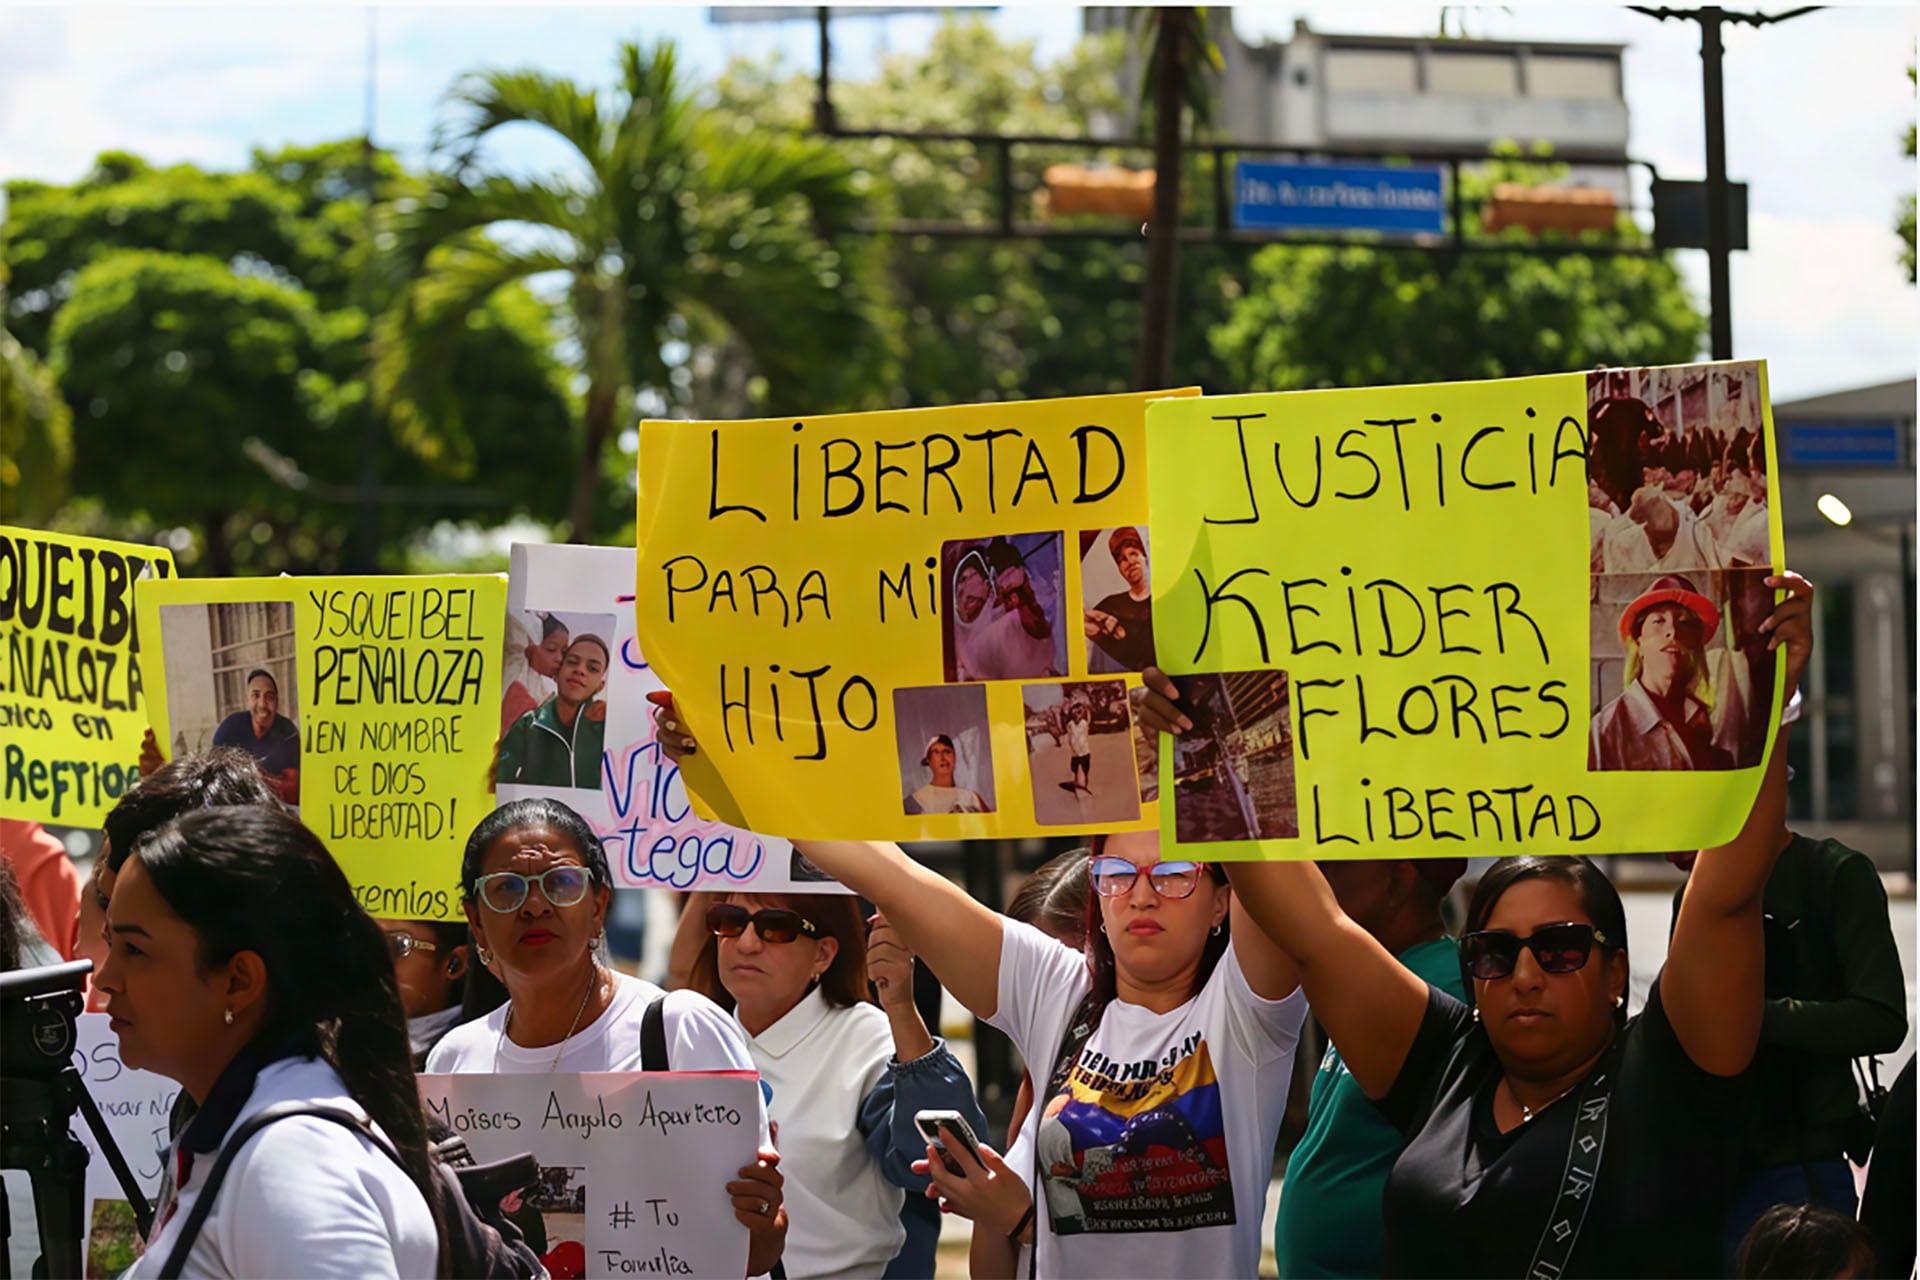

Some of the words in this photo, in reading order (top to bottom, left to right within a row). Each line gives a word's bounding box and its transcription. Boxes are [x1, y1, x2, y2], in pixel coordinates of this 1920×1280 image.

[309, 588, 484, 641] YSQUEIBEL
[661, 555, 831, 628] PARA
[313, 644, 484, 706] PEÑALOZA
[359, 714, 463, 754] NOMBRE
[1295, 674, 1570, 760] FLORES
[334, 764, 361, 796] DE
[372, 762, 426, 796] DIOS
[330, 797, 457, 841] LIBERTAD!
[645, 1198, 679, 1227] Tu
